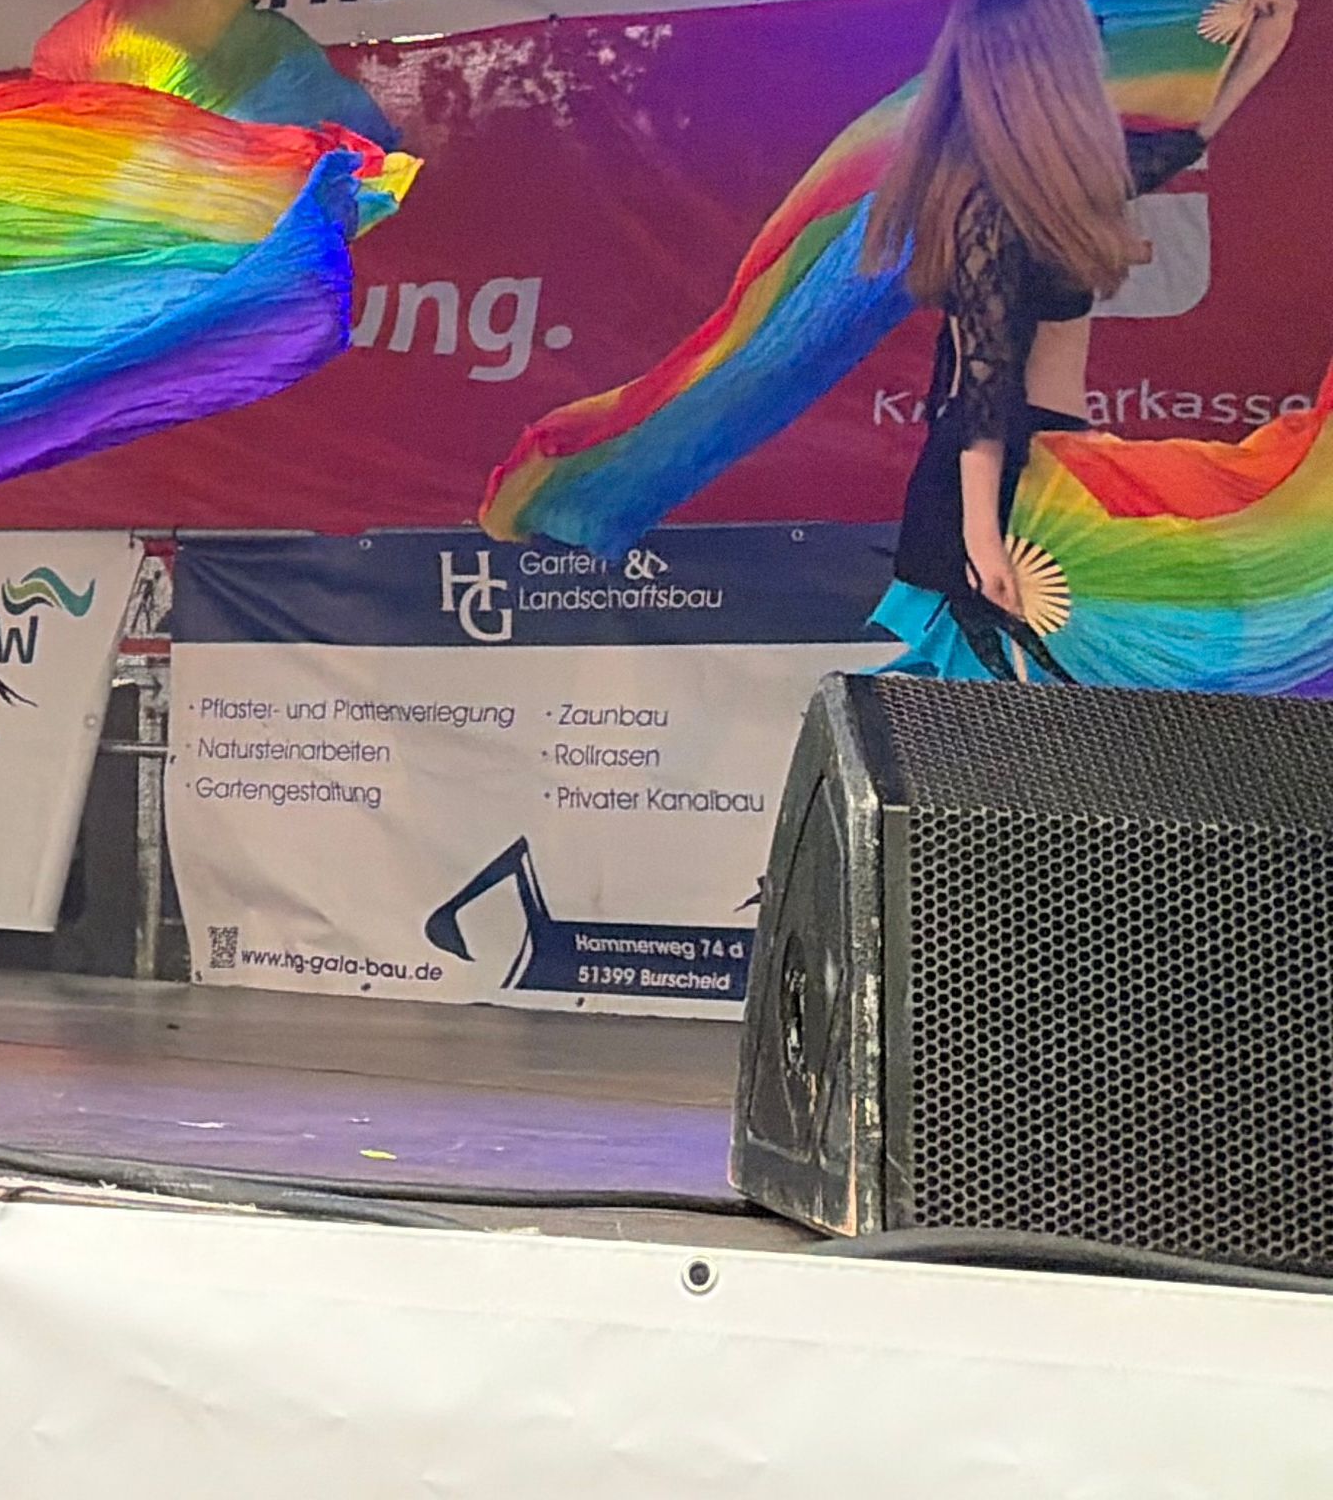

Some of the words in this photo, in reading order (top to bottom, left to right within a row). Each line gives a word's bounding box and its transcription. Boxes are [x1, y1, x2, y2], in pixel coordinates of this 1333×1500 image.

[519, 585, 723, 611] Landschaftsbau
[200, 698, 280, 720] Pflaster-
[286, 701, 327, 720] und
[333, 700, 515, 728] Plattenverlegung
[558, 704, 669, 727] Zaunbau
[197, 737, 390, 763] Natursteinarbeiten
[555, 743, 660, 767] Rollrasen
[195, 776, 382, 809] Gartengestaltung
[557, 786, 640, 810] Privater
[646, 789, 765, 813] Kanalbau
[575, 934, 696, 960] Hammerweg
[700, 938, 724, 958] 74
[729, 941, 744, 959] d
[241, 949, 443, 981] www.hg-gala-bau.de
[578, 965, 635, 985] 51399
[640, 968, 731, 991] Burscheid
